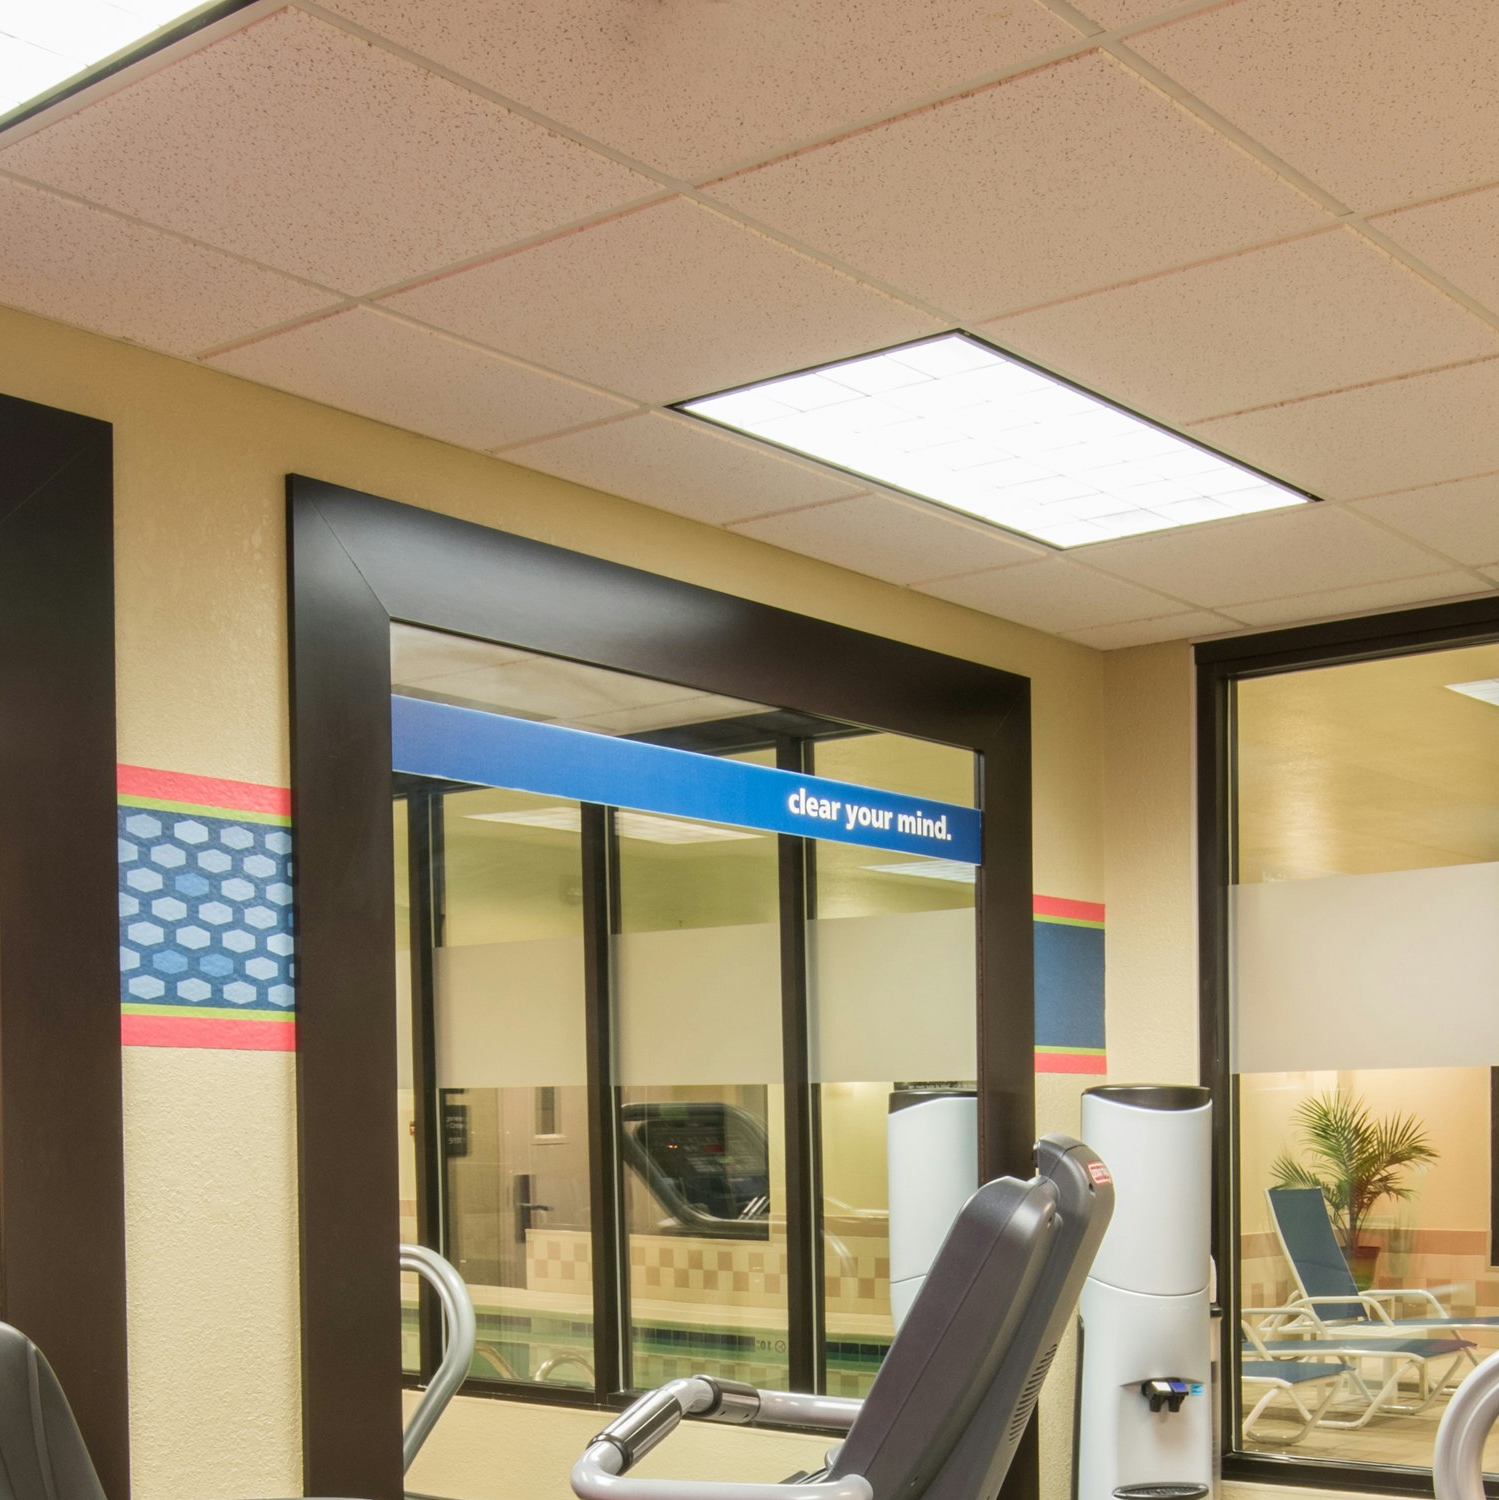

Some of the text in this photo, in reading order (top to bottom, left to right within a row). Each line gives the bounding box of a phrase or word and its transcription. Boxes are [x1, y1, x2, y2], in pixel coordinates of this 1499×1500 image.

[788, 788, 952, 841] clear your mind.
